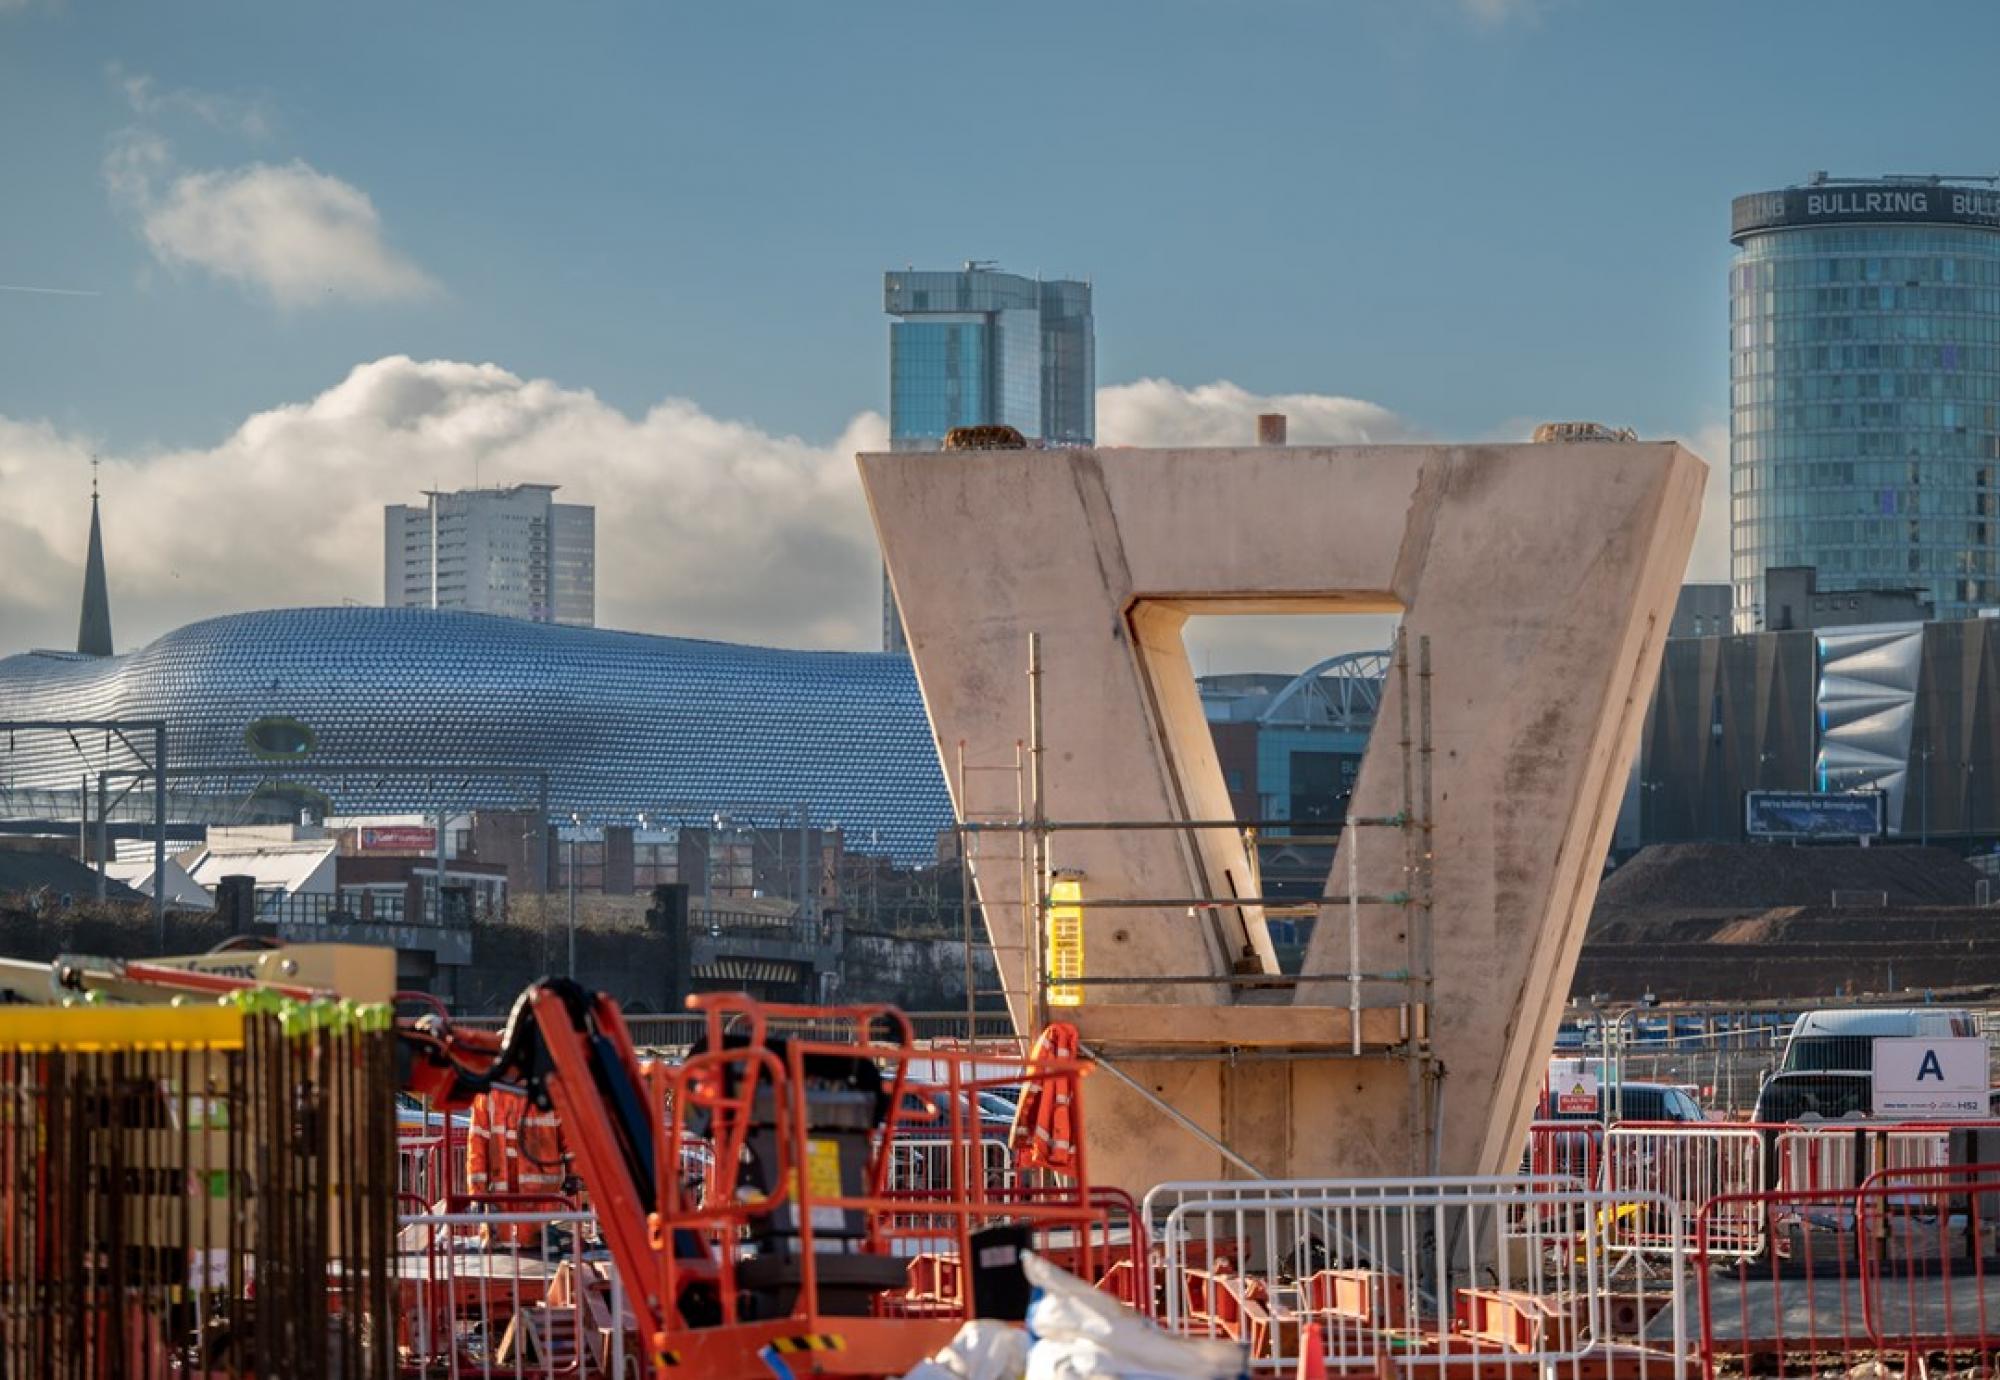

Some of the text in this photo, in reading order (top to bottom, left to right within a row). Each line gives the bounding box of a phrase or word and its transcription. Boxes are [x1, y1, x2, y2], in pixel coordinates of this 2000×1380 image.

[1808, 192, 1928, 214] BULLRING
[1917, 1050, 1944, 1081] A
[1957, 1101, 1978, 1110] HS2
